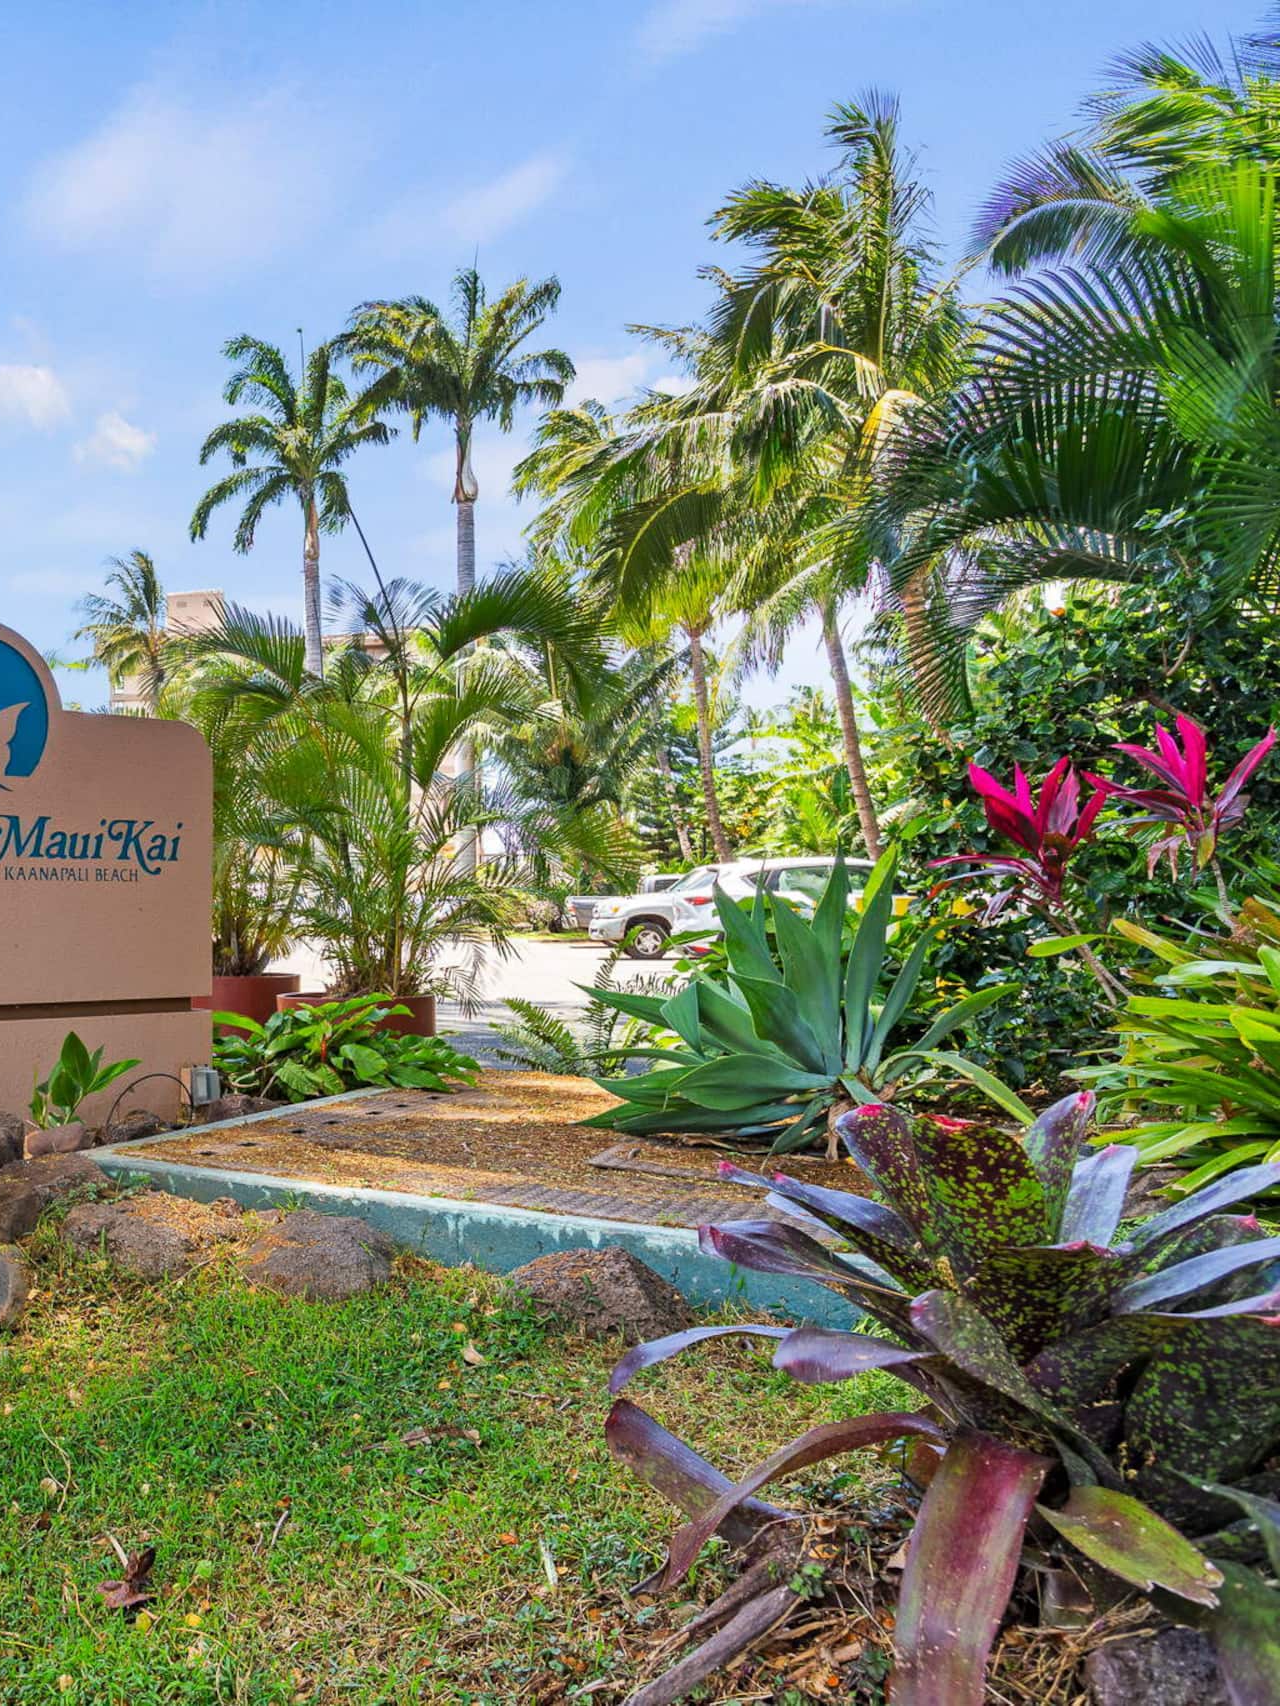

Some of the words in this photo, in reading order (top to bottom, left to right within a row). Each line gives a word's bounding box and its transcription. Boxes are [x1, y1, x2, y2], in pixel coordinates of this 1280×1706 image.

[108, 820, 183, 875] Kai
[4, 866, 89, 881] KAANAPALI
[96, 868, 138, 882] BEACH
